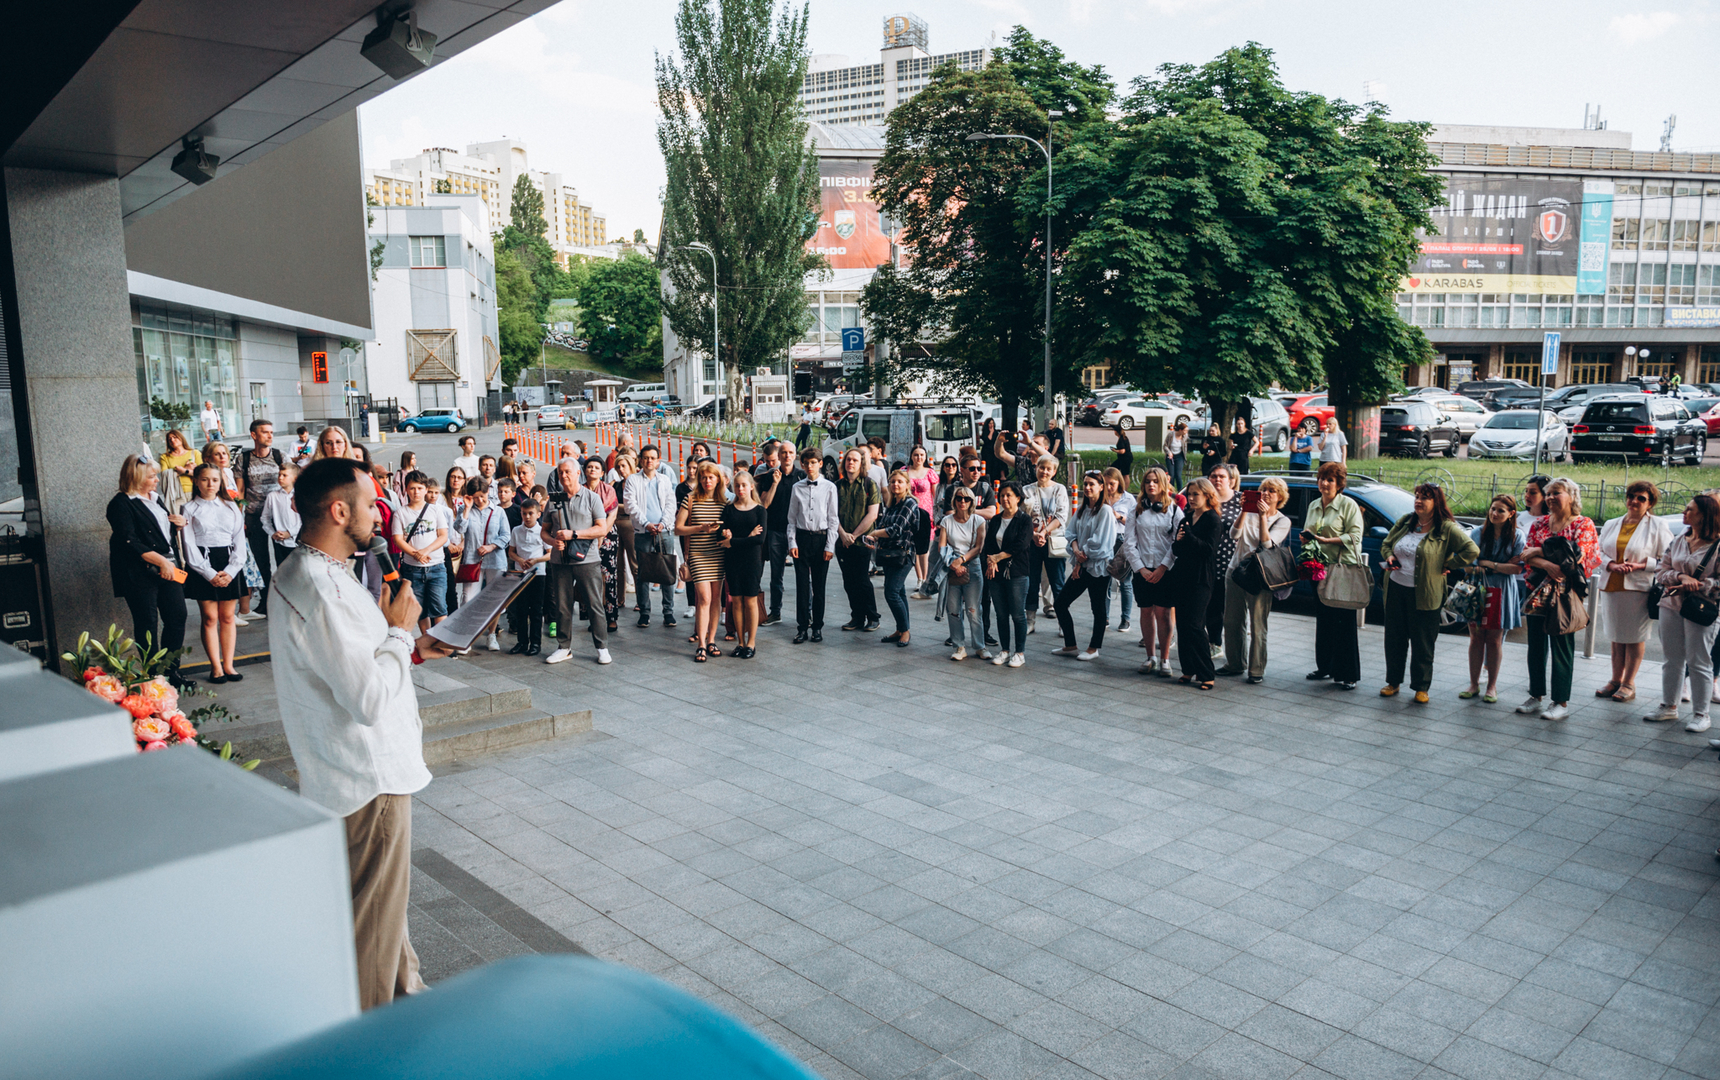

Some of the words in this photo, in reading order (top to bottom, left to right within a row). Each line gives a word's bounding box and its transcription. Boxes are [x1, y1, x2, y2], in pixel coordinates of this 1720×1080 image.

[1472, 194, 1527, 220] ЖАДАН
[1546, 215, 1557, 235] 1
[1424, 278, 1484, 288] KARABAS
[849, 335, 859, 349] P
